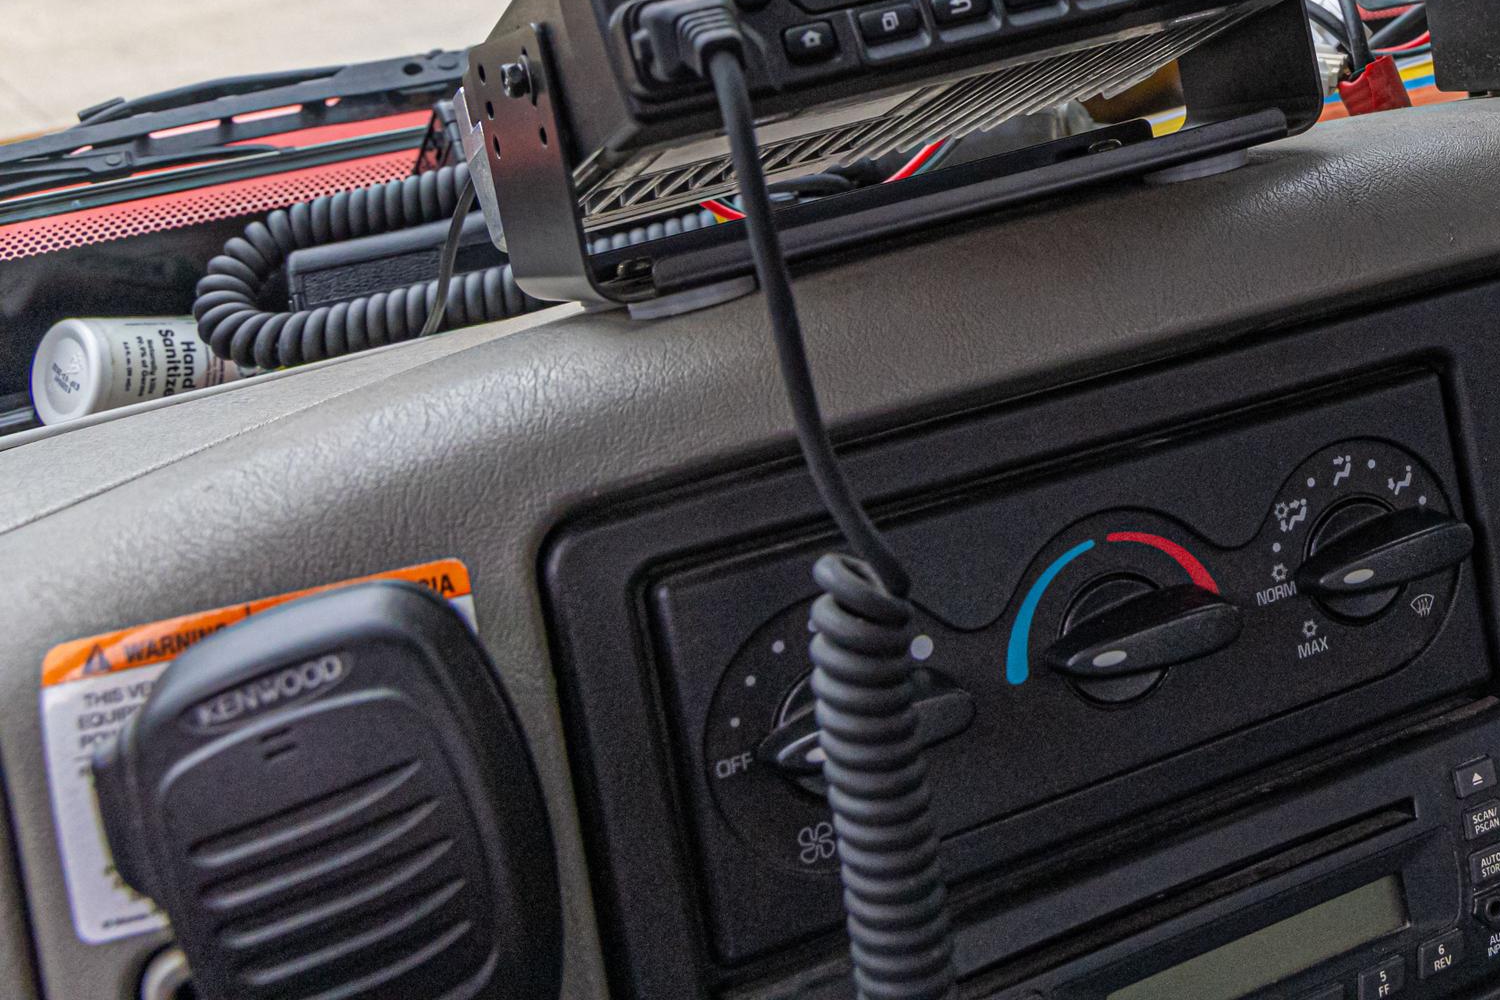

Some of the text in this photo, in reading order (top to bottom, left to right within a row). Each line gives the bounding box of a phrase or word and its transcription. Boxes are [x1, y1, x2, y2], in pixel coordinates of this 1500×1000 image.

[158, 329, 182, 397] Sanitize
[181, 341, 197, 389] Hand
[1255, 580, 1297, 607] NORM
[125, 624, 226, 663] WARNI
[1297, 636, 1329, 659] MAX
[199, 654, 343, 727] KENWOOD
[716, 752, 753, 779] OFF
[1472, 806, 1497, 824] SCAN/
[1475, 817, 1500, 834] PSCAN
[1437, 943, 1445, 955] 6
[1434, 954, 1453, 972] REV
[1379, 970, 1387, 983] 5
[1378, 983, 1390, 998] FF
